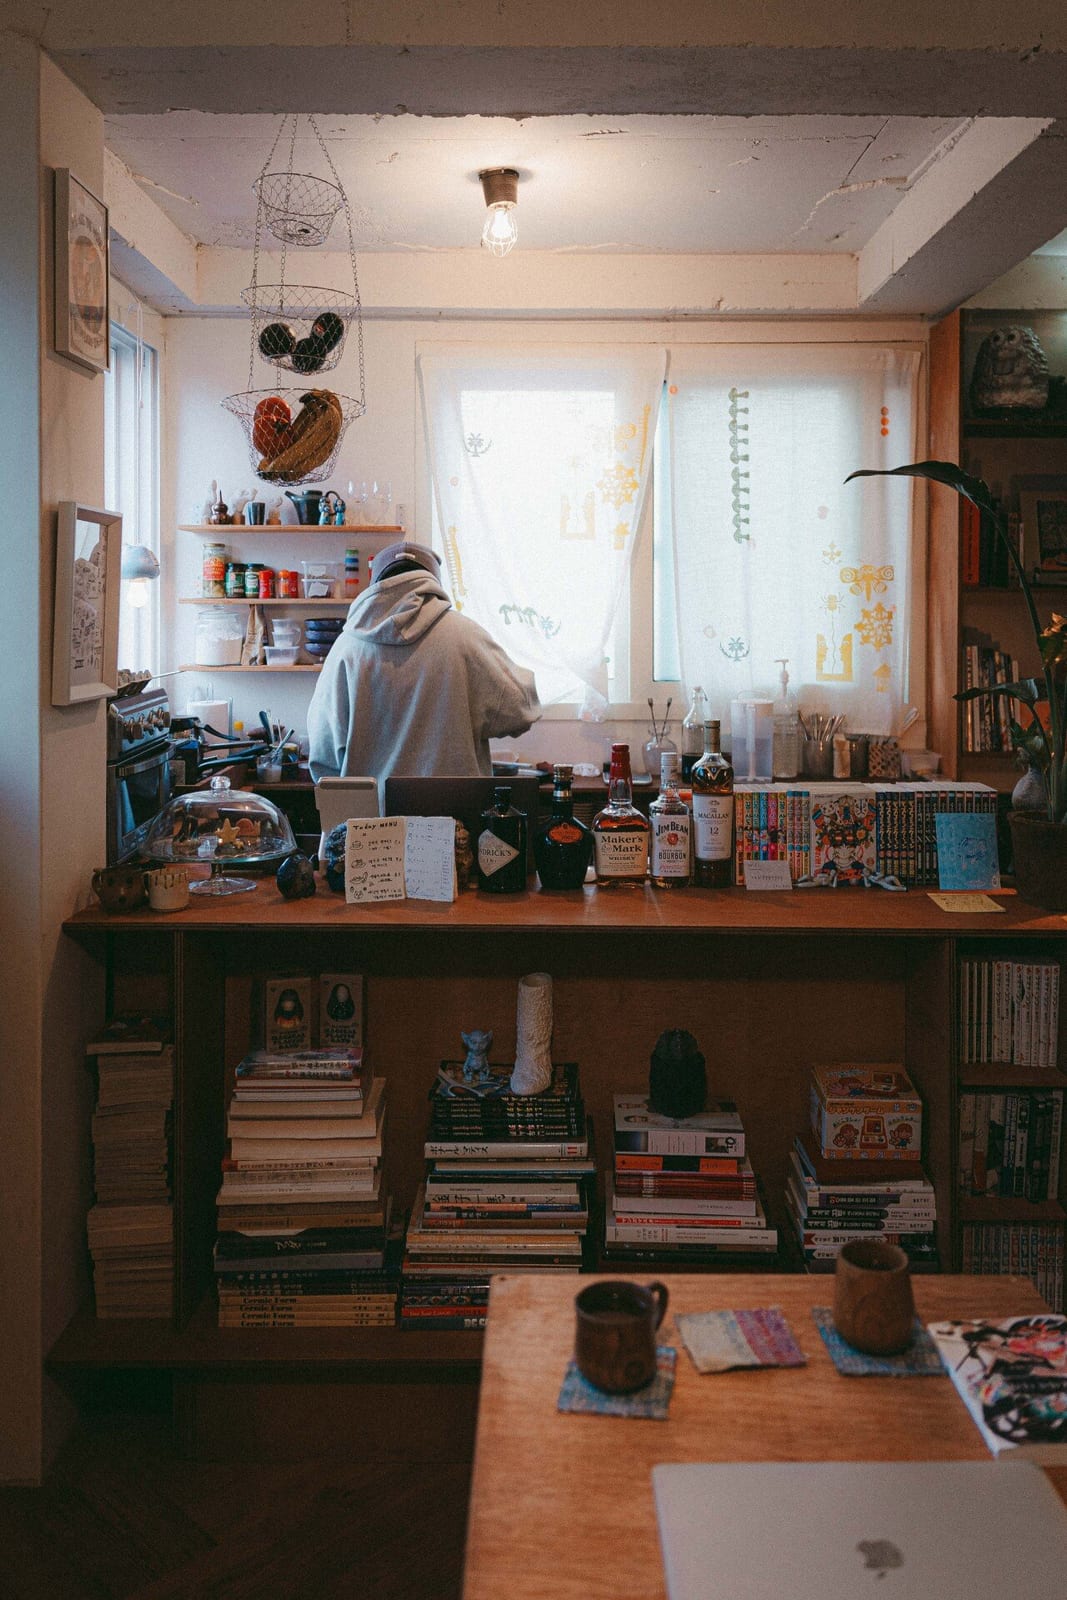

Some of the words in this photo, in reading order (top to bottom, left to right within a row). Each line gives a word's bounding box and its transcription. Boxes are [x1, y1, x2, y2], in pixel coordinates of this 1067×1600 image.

[655, 824, 670, 837] JIM
[670, 821, 688, 836] BEAM
[709, 826, 719, 835] 12
[601, 835, 643, 844] Maker's
[612, 844, 643, 853] Mark
[658, 851, 686, 860] BOURBON
